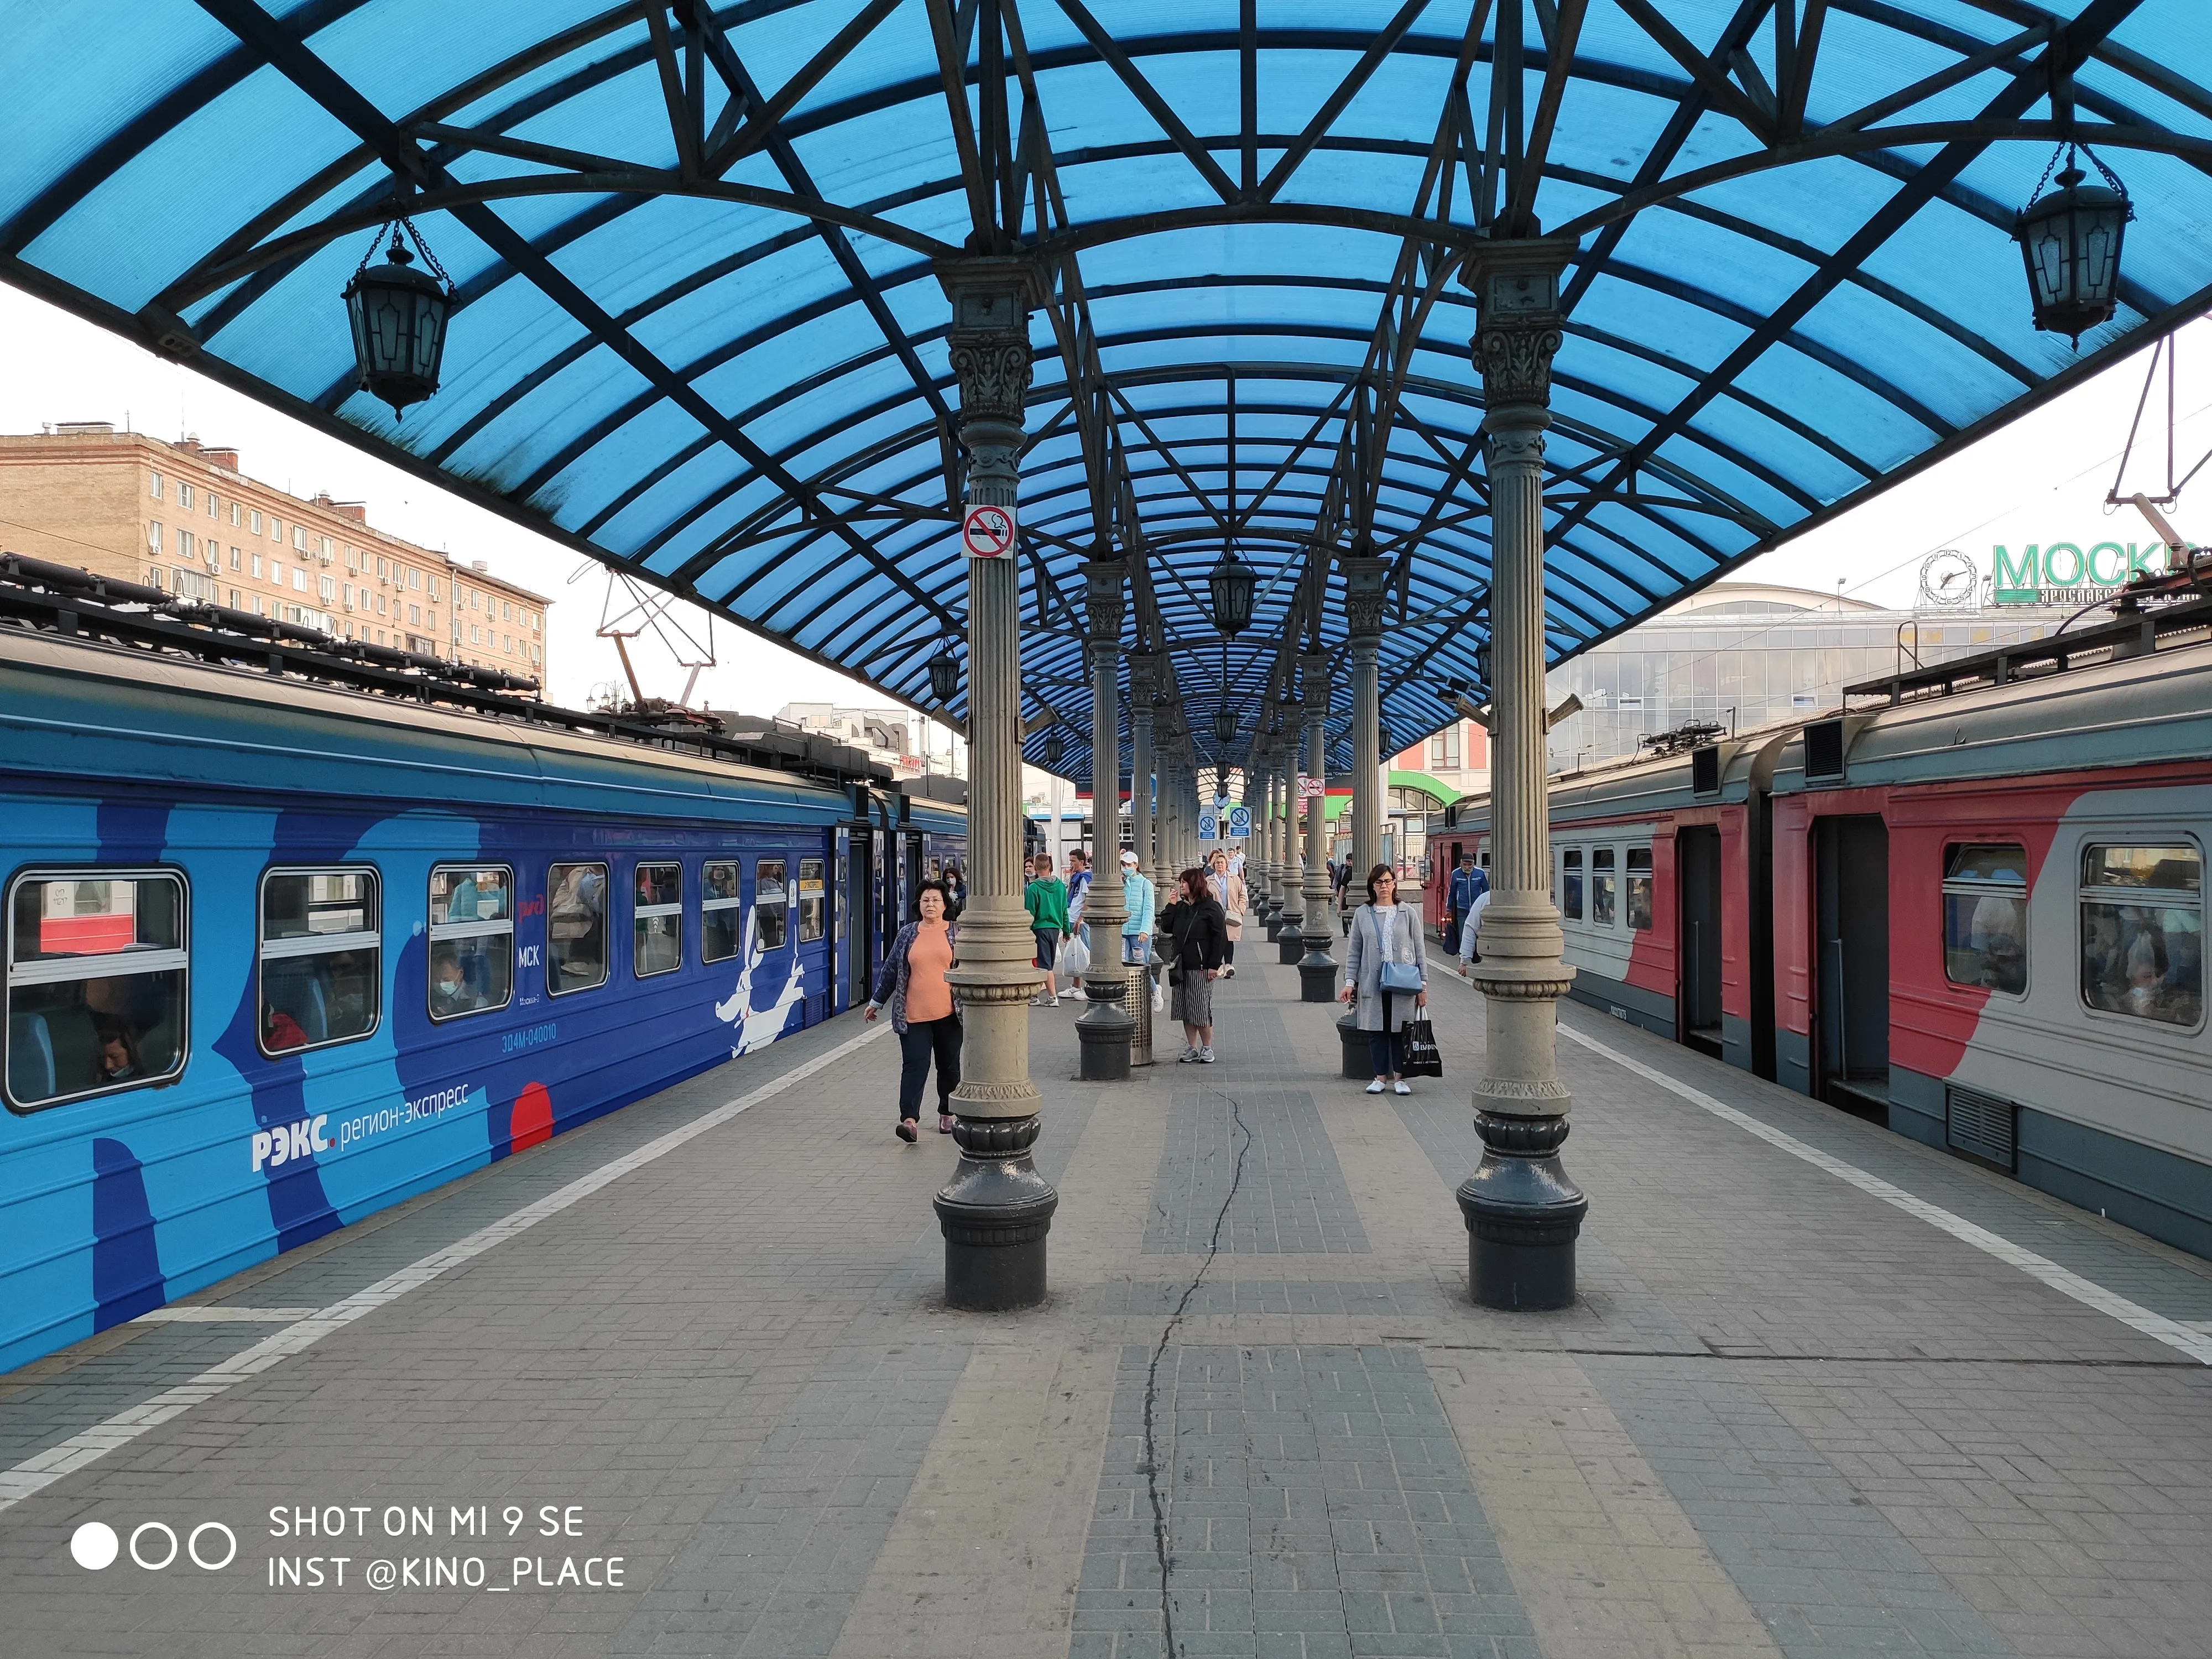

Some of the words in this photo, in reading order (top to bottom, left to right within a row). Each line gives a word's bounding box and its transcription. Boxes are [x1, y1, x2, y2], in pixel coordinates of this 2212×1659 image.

[2041, 589, 2124, 603] ЯРОСЛАВС
[519, 945, 540, 968] МСК
[340, 1083, 469, 1152] регион-экспресс
